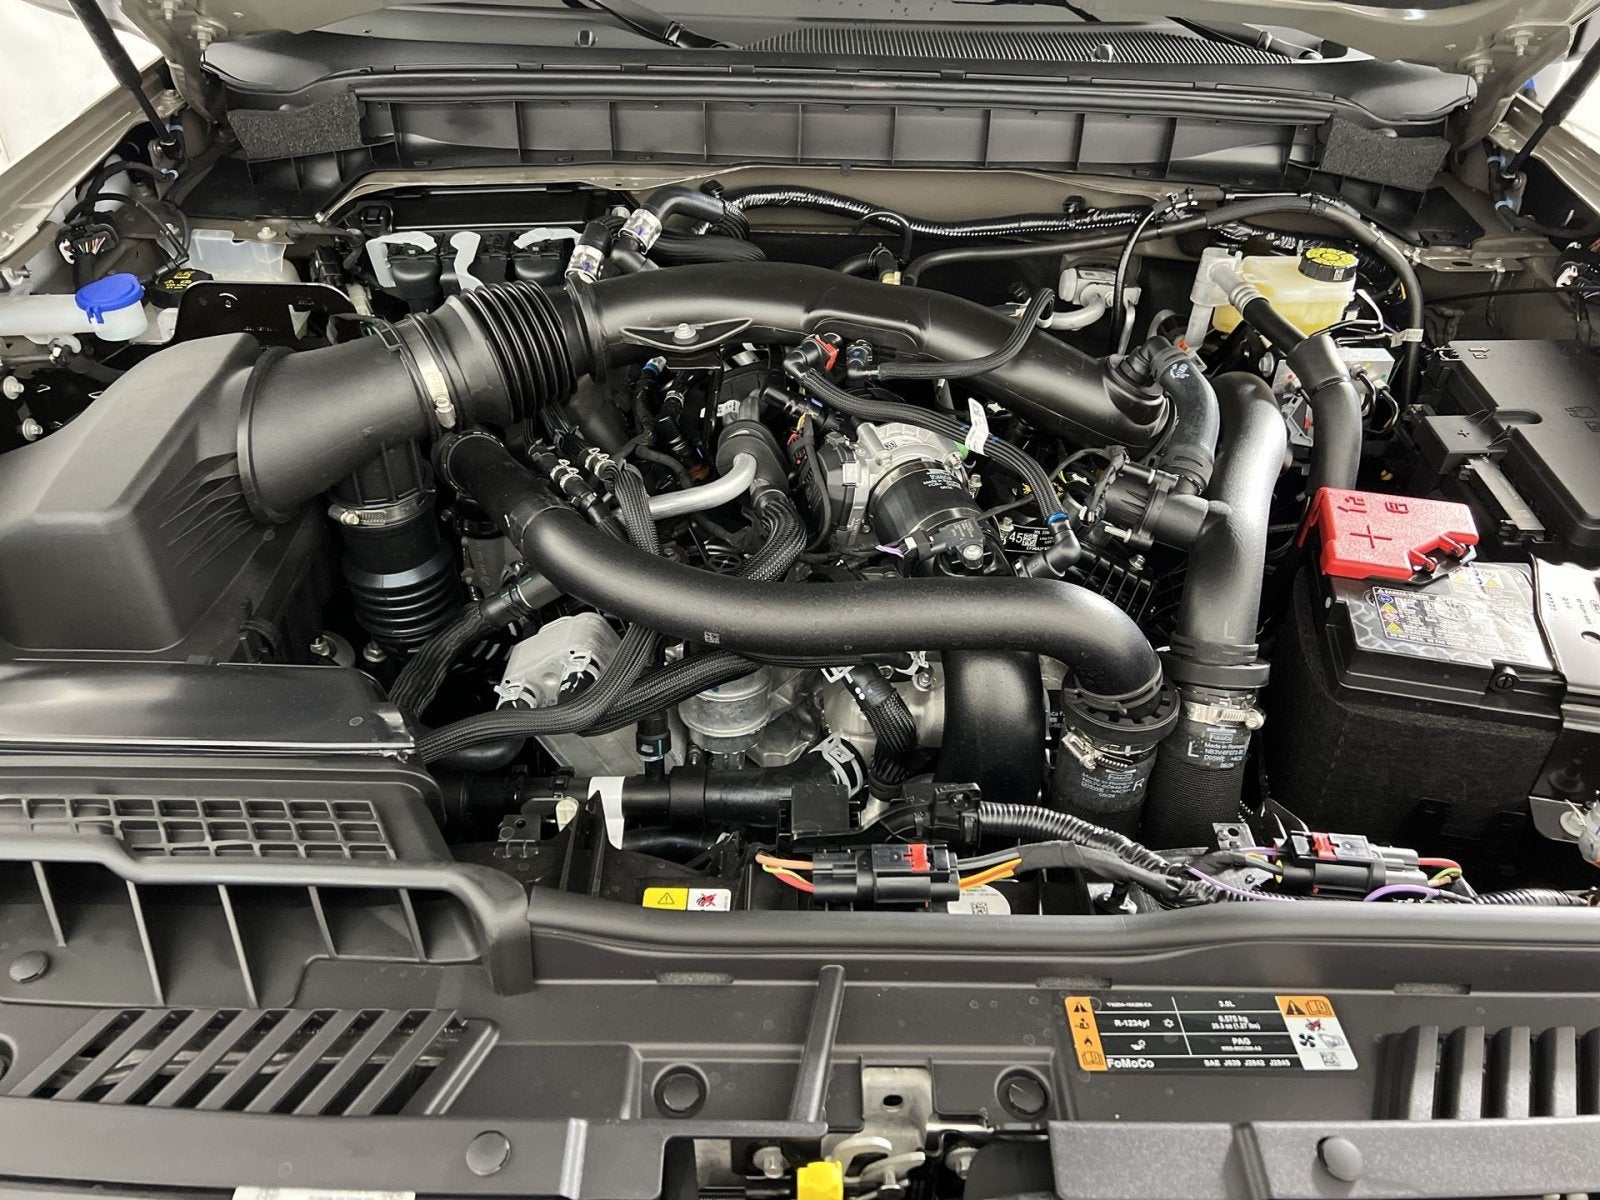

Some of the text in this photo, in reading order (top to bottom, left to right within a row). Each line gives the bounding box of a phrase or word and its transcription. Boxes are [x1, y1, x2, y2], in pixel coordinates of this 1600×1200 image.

[1009, 531, 1023, 544] 45
[1223, 621, 1236, 640] L
[1187, 741, 1199, 758] L
[1132, 777, 1145, 792] R
[1219, 1000, 1236, 1008] 3.0L
[1114, 1019, 1150, 1028] R-1234yf
[1238, 1015, 1249, 1023] kg
[1232, 1037, 1252, 1045] PAG
[1106, 1058, 1155, 1069] FoMoCo
[1203, 1059, 1221, 1067] SAE
